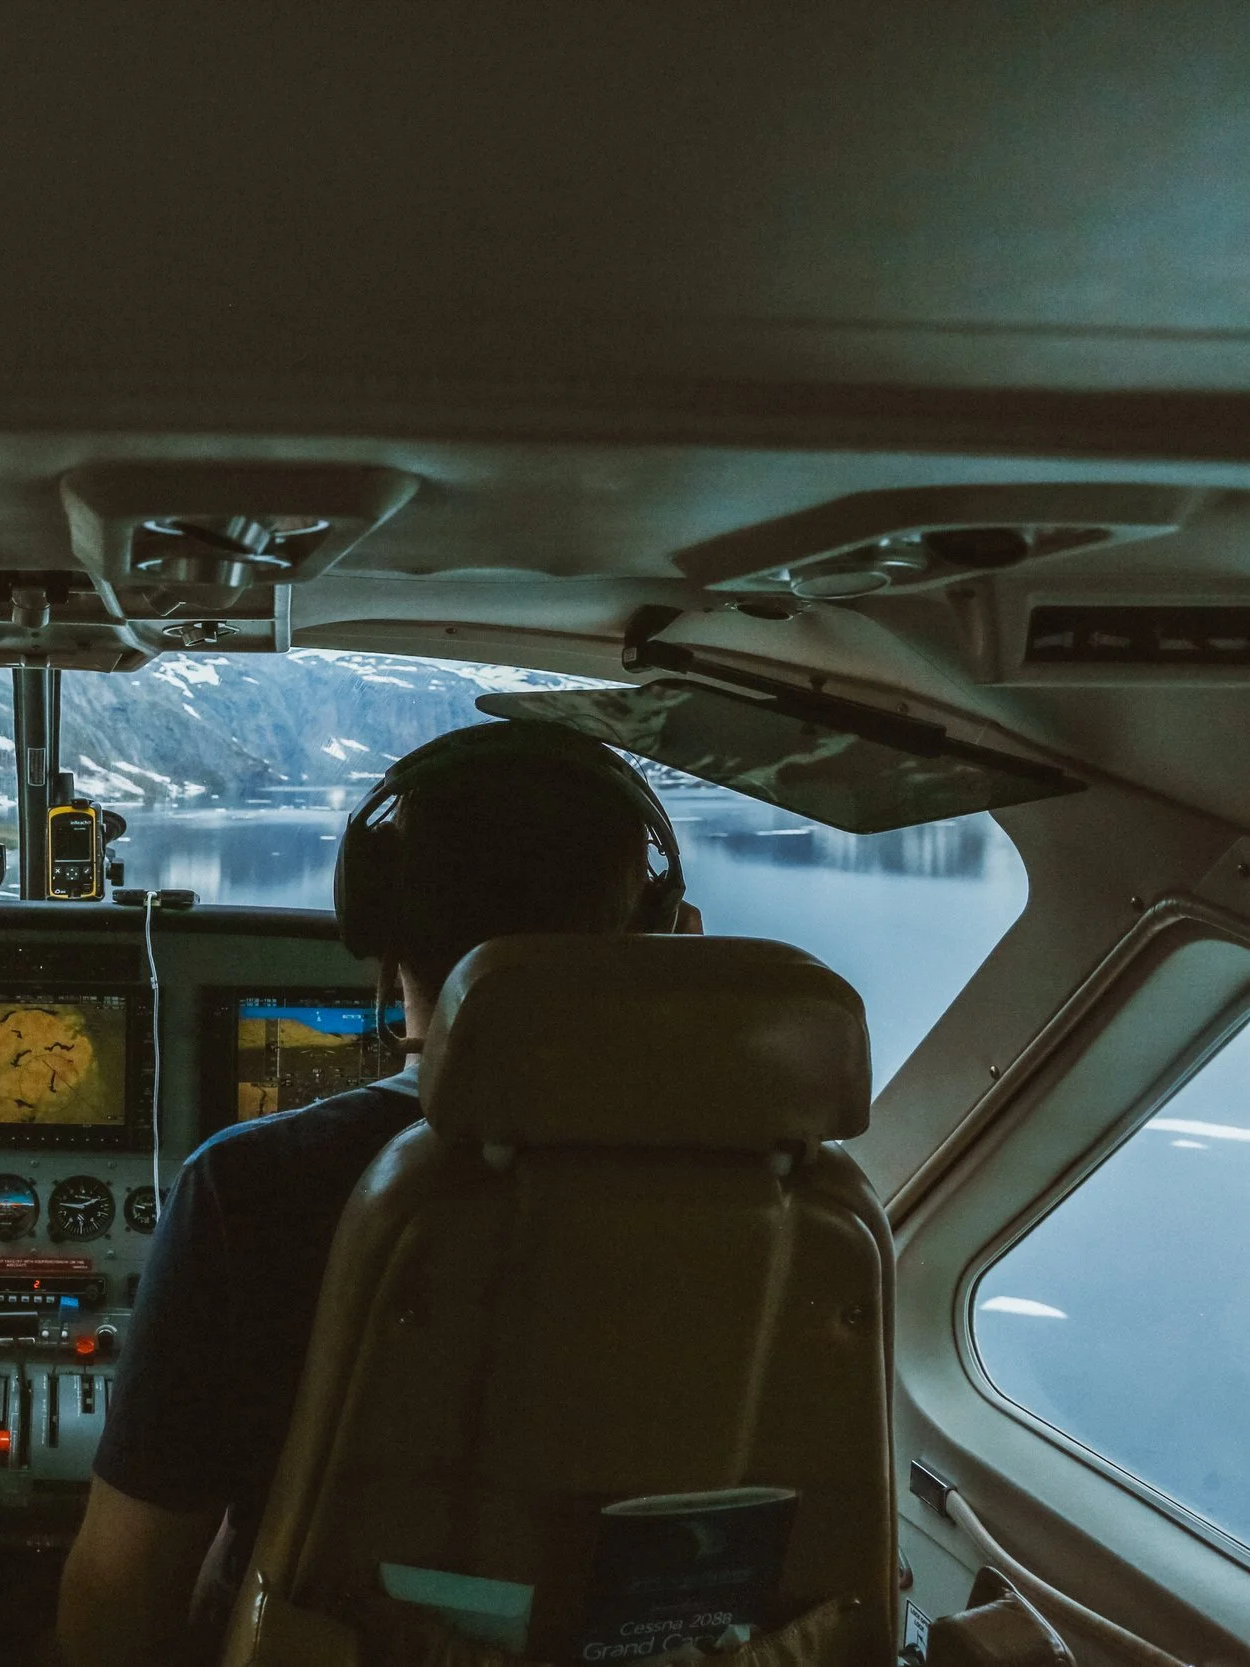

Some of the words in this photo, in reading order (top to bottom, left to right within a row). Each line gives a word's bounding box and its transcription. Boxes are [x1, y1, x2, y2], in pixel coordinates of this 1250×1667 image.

[33, 1279, 41, 1289] 2
[619, 1617, 684, 1637] Cessna
[582, 1636, 655, 1662] Grand
